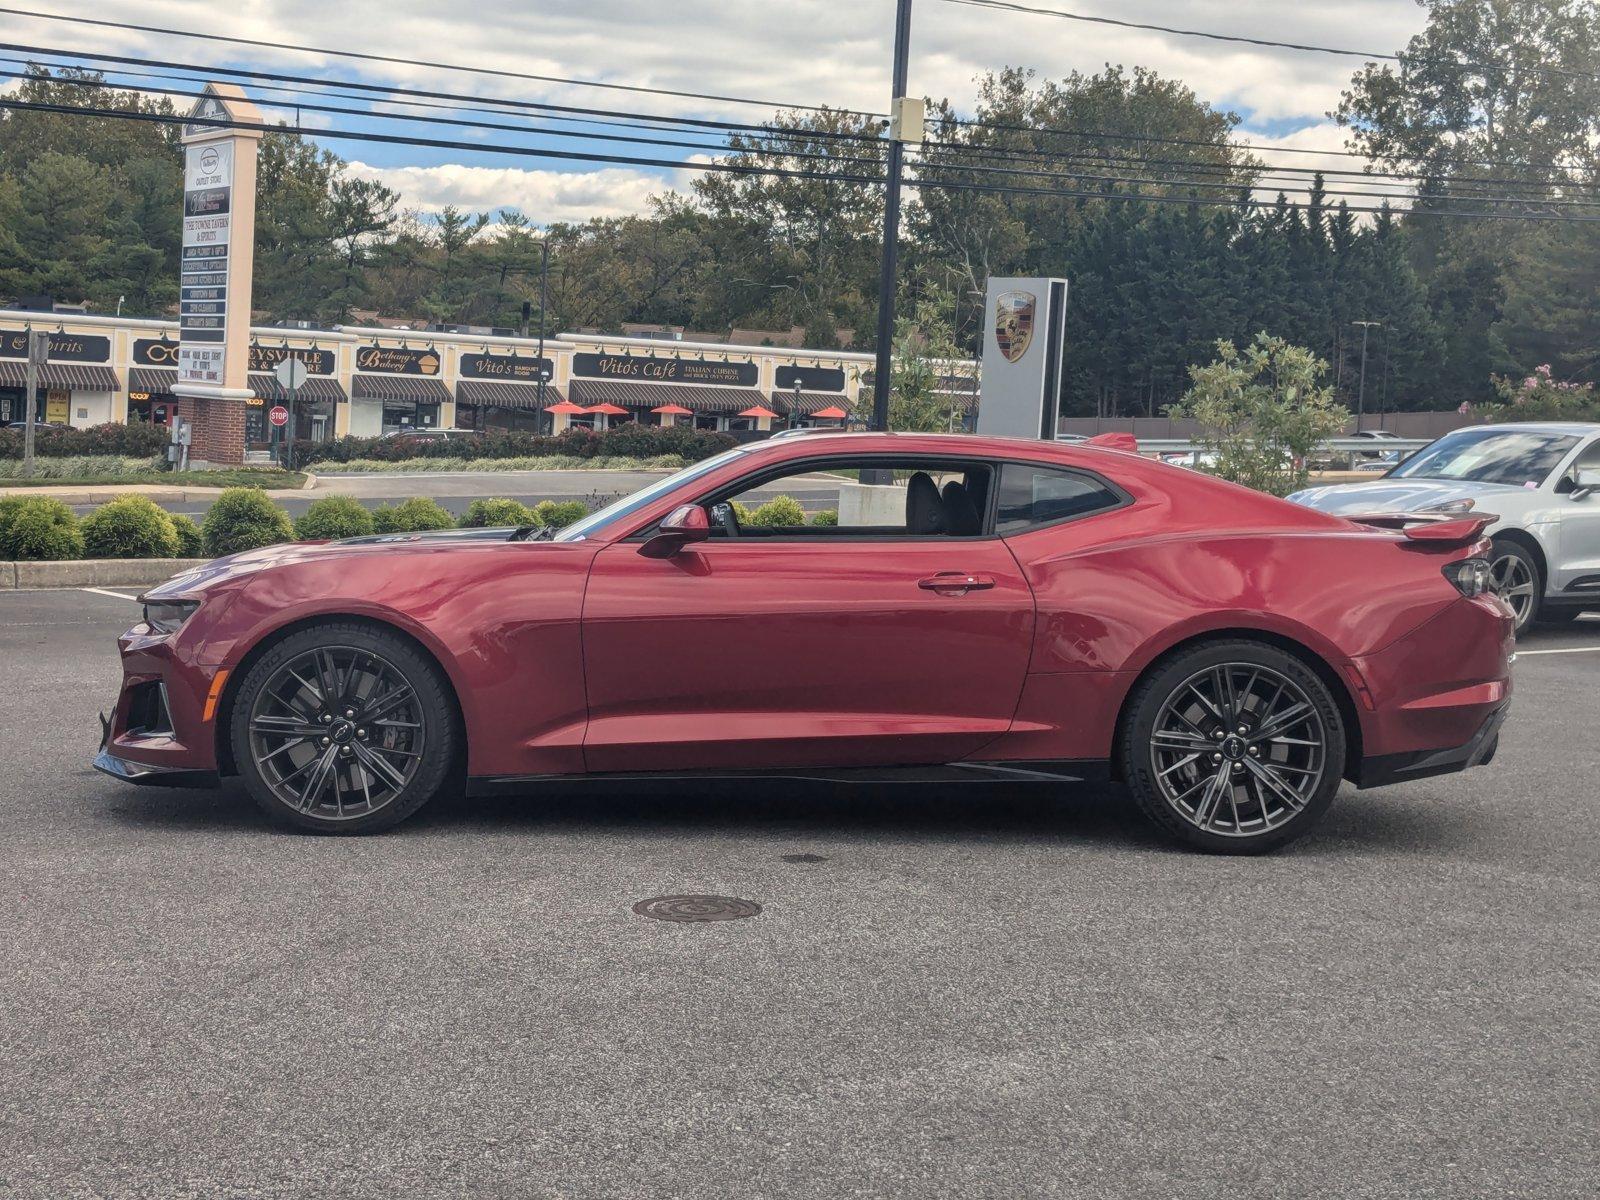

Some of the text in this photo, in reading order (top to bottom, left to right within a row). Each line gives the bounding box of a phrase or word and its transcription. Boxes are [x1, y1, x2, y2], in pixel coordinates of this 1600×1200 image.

[210, 175, 221, 185] STORE
[186, 220, 195, 230] THE
[212, 217, 229, 229] TAVERN
[249, 348, 322, 364] EYSVILLE
[358, 350, 417, 369] Bethany's
[476, 359, 512, 375] Vito's
[599, 358, 678, 379] Vito's Café
[271, 412, 287, 420] STOP
